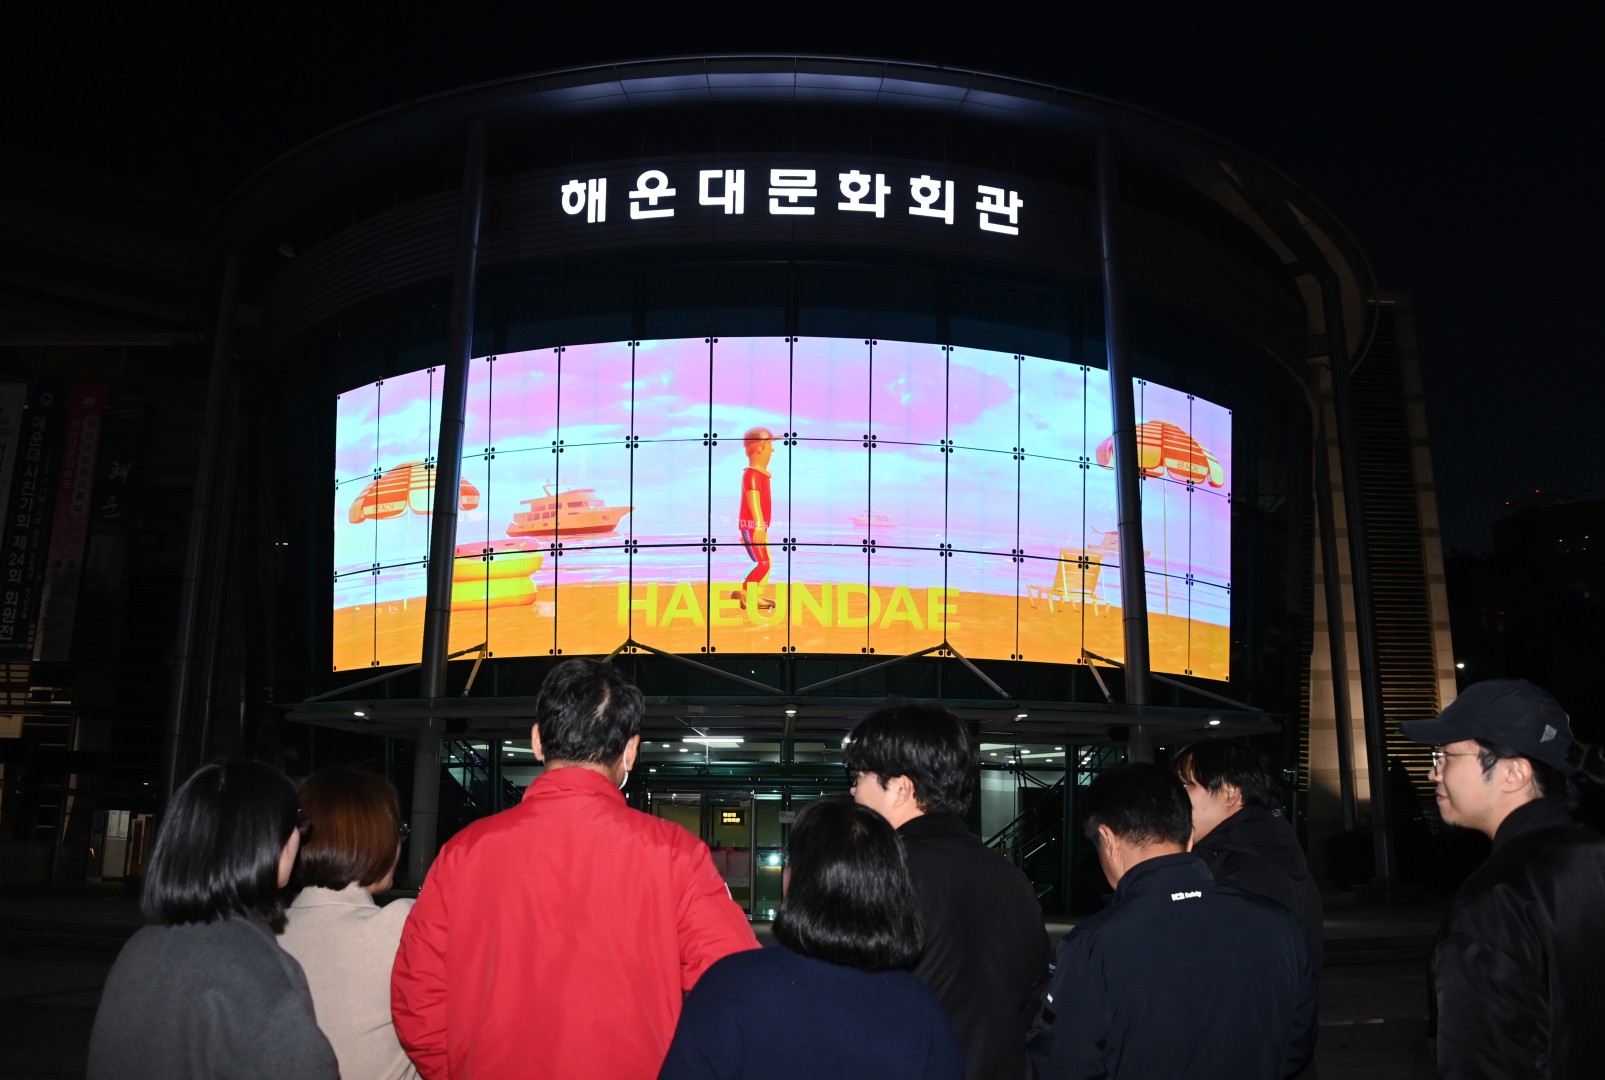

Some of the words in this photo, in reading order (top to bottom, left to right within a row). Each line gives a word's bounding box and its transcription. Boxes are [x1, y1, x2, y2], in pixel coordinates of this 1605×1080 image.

[561, 169, 1024, 235] 해운대문화회관
[1177, 461, 1199, 473] BEACH
[372, 503, 394, 513] BEACH
[617, 581, 961, 632] HAEUNDAE
